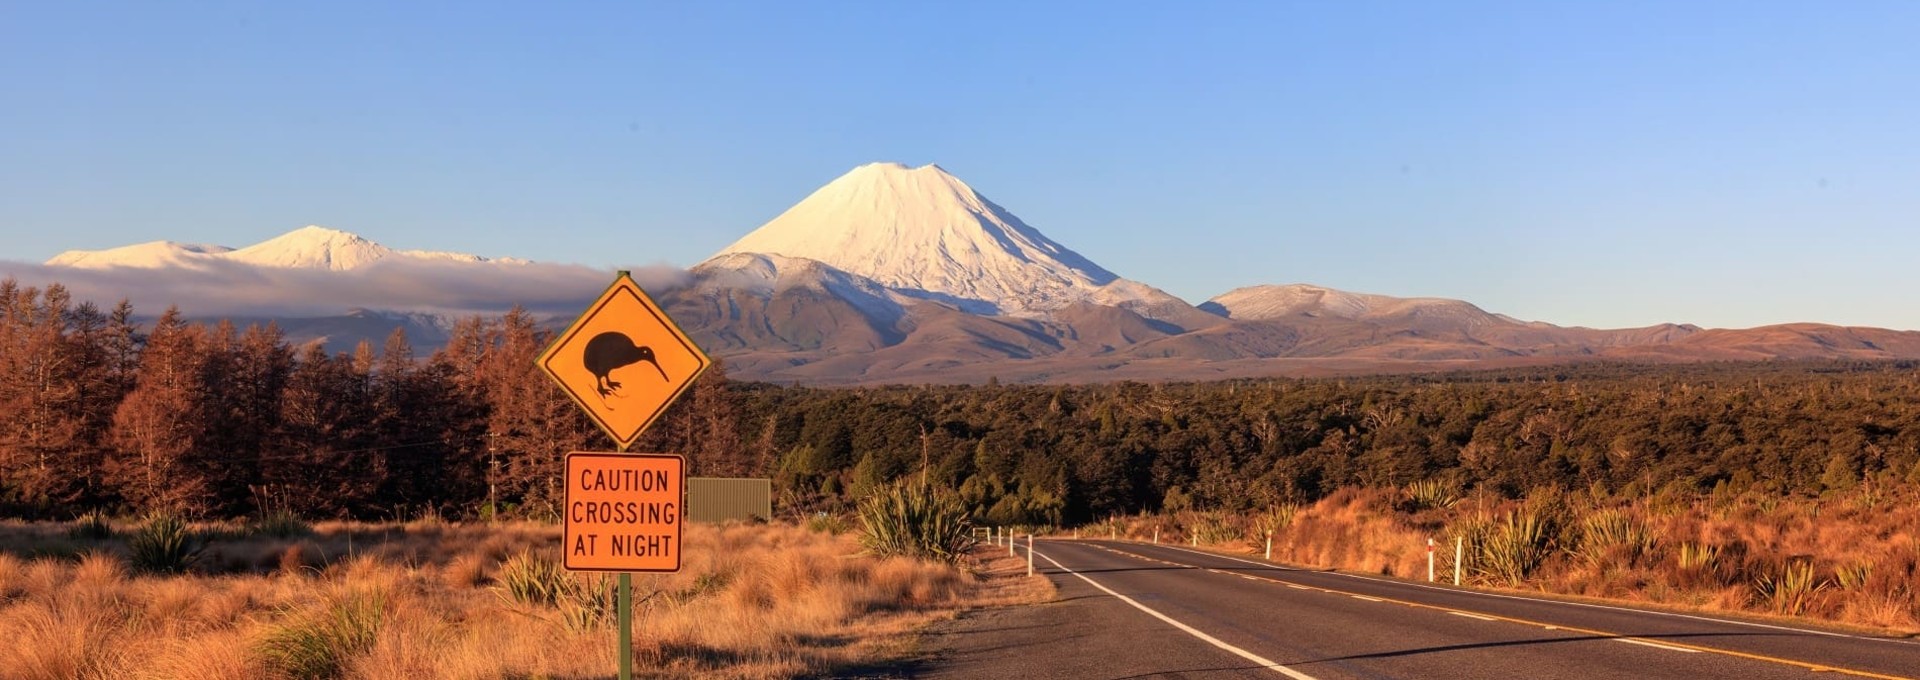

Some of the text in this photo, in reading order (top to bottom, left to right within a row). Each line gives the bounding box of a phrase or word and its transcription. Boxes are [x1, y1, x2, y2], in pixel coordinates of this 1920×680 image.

[581, 469, 668, 491] CAUTION
[572, 502, 675, 524] CROSSING
[574, 535, 672, 556] AT NIGHT
